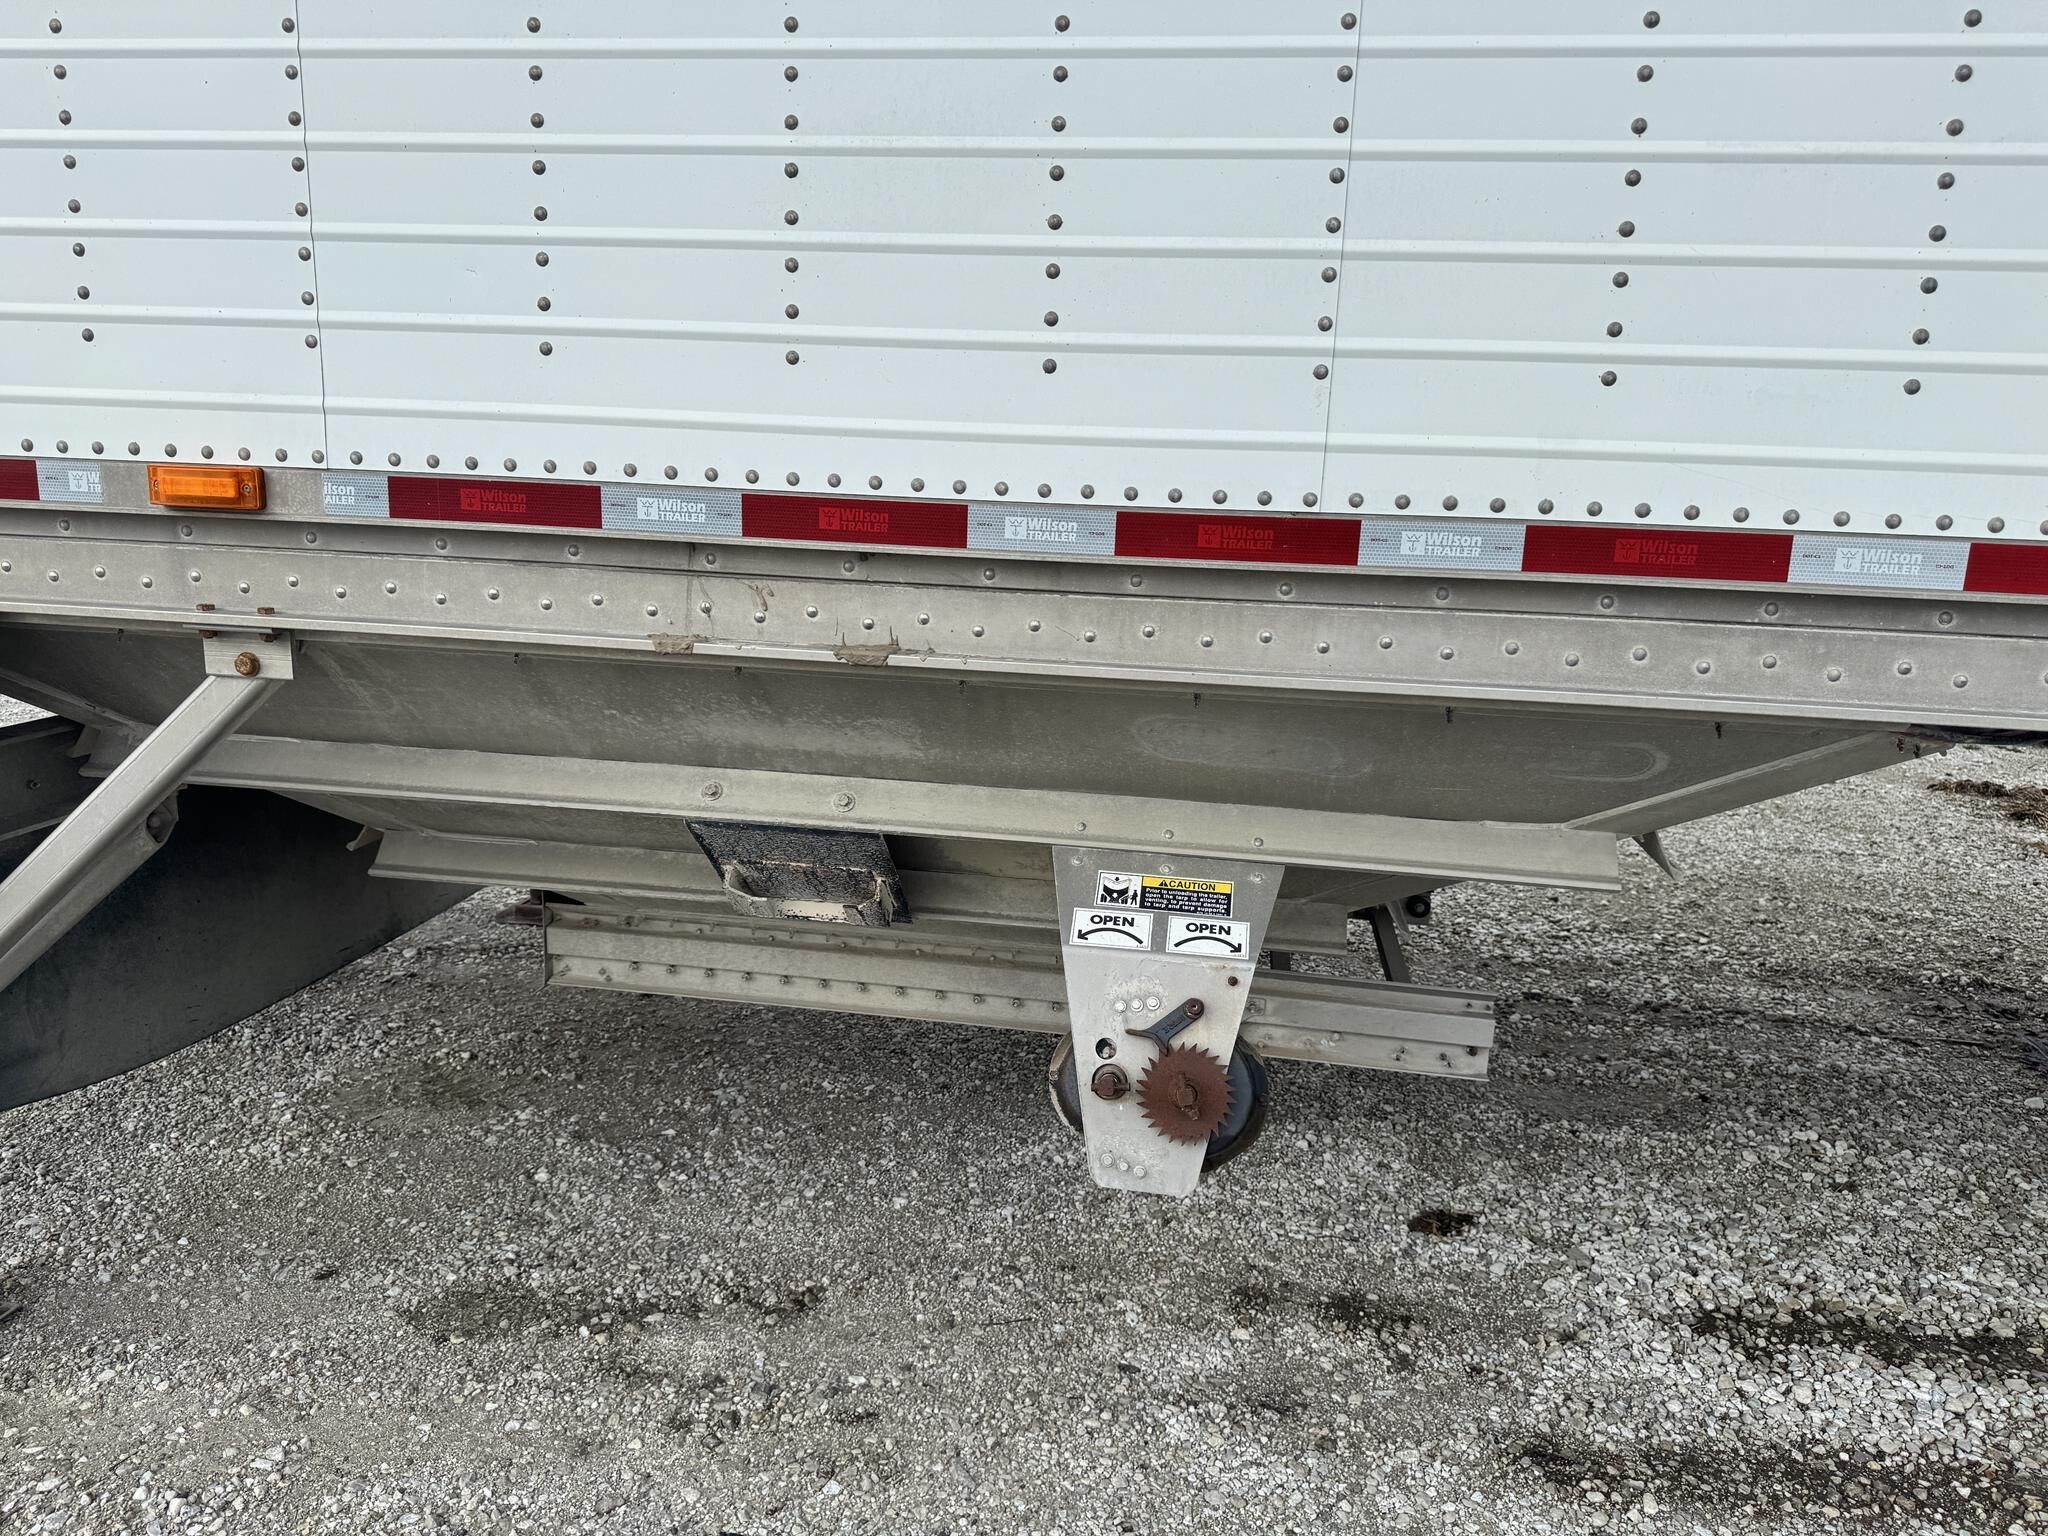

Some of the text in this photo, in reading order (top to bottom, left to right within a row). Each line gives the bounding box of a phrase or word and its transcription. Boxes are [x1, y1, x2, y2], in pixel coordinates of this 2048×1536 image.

[481, 489, 526, 502] Wilson
[481, 503, 526, 513] TRAILER
[658, 499, 706, 512] Wilson
[658, 511, 705, 522] TRAILER
[841, 508, 889, 522] Wilson
[841, 521, 888, 532] TRAILER
[1027, 518, 1077, 531] Wilson
[1027, 530, 1076, 542] TRAILER
[1221, 526, 1274, 540] Wilson
[1426, 532, 1482, 547] Wilson
[1221, 538, 1273, 550] TRAILER
[1640, 540, 1698, 554] Wilson
[1425, 545, 1481, 557] TRAILER
[1861, 549, 1923, 564] Wilson
[1640, 553, 1696, 565] TRAILER
[1861, 562, 1921, 575] TRAILER
[1169, 880, 1216, 891] CAUTION
[1090, 914, 1135, 927] OPEN
[1186, 922, 1231, 936] OPEN
